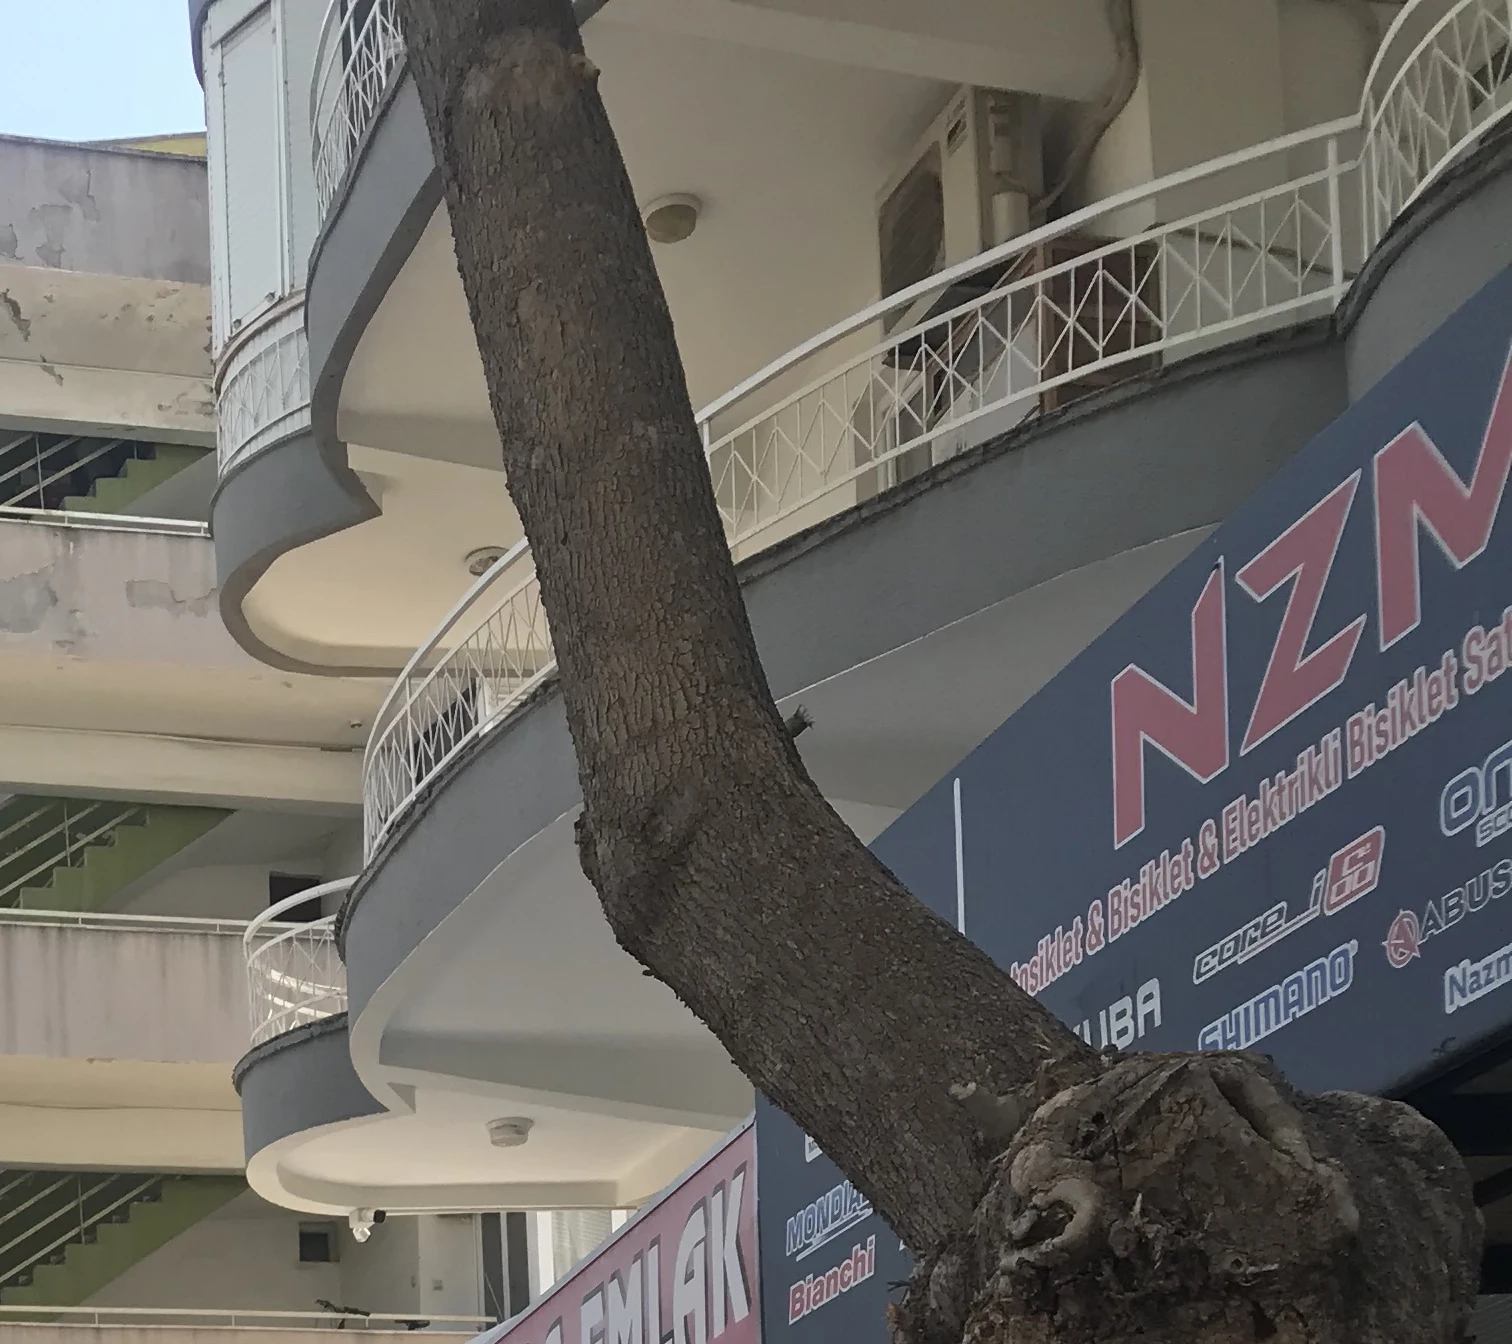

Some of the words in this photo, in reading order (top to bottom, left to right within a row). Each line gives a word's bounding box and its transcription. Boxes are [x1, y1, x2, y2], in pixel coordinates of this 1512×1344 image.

[1086, 899, 1107, 956] &
[1108, 837, 1194, 944] Bisiklet
[1197, 818, 1218, 879] &
[1222, 726, 1342, 865] Elektrikli
[1346, 650, 1459, 780] Bisiklet
[1072, 977, 1162, 1051] UBA
[789, 1234, 876, 1325] Bianchi
